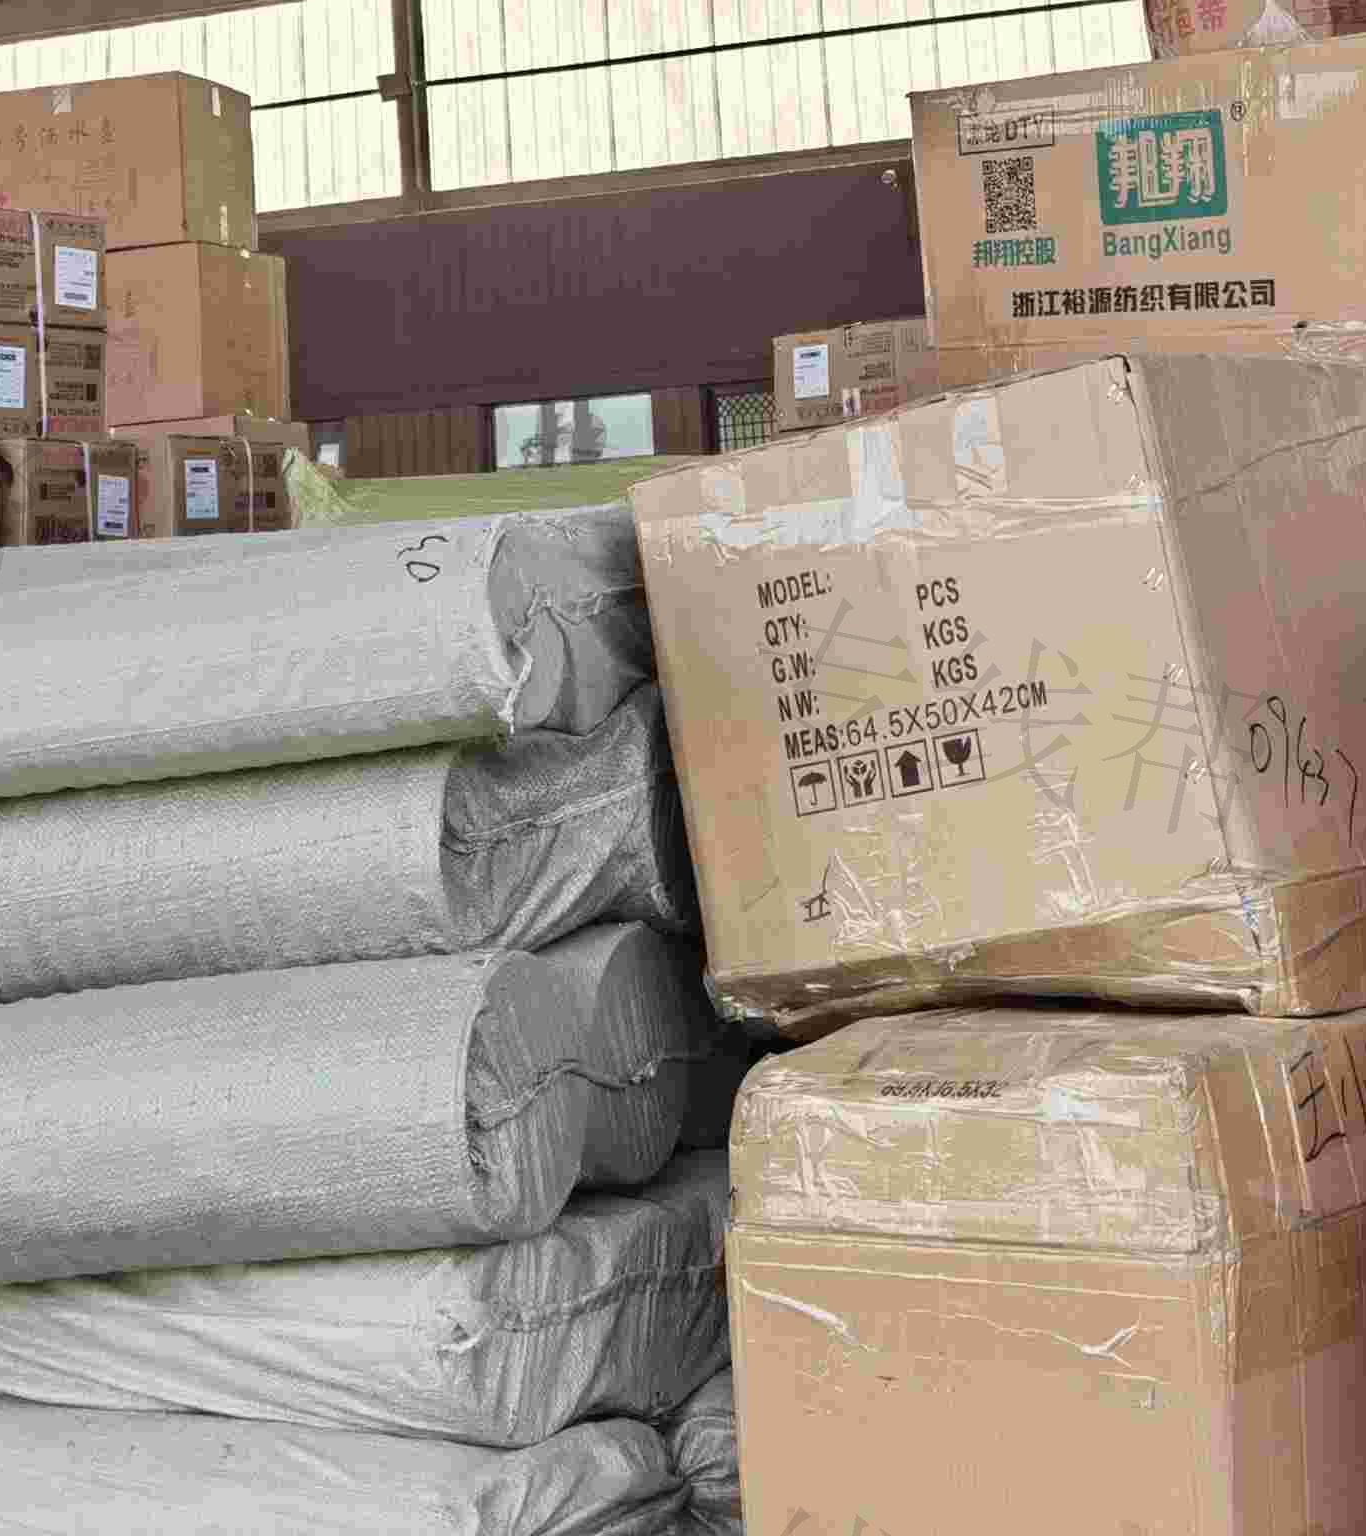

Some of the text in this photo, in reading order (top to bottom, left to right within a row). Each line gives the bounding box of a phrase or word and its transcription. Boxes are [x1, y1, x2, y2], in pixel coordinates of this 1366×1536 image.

[971, 237, 1057, 268] 邦翔控股
[1102, 224, 1232, 260] BangXiang
[1011, 279, 1276, 318] 浙江裕源纺织有限公司
[756, 569, 832, 609] MODEL:
[764, 576, 961, 647] QTY: PCS
[771, 615, 970, 683] G.W: KGS
[931, 653, 979, 688] KGS
